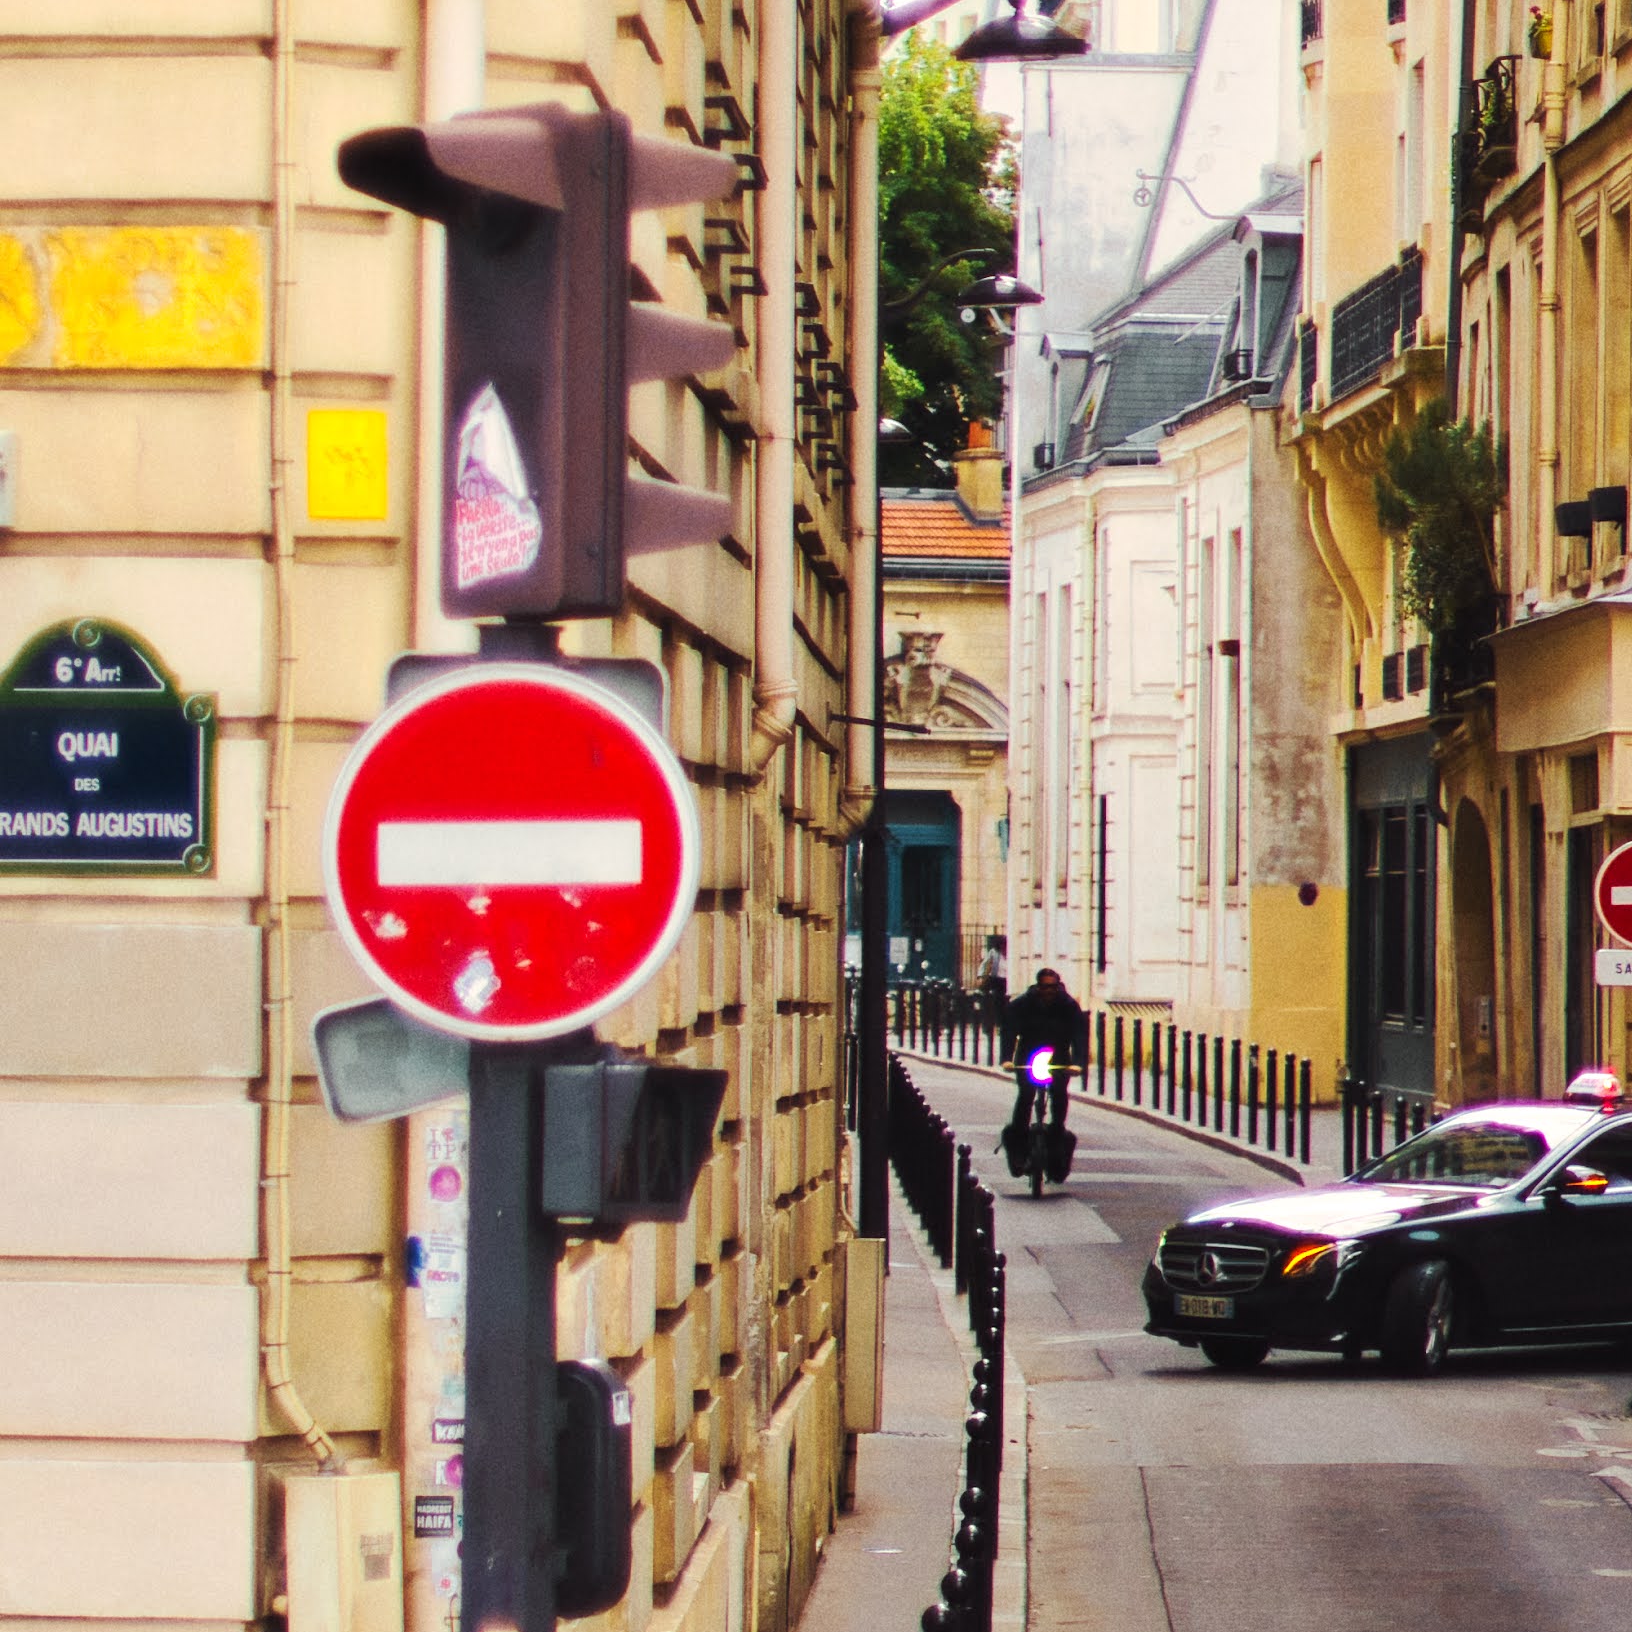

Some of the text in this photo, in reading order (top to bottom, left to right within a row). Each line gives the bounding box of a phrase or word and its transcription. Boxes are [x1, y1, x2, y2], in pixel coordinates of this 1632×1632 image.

[58, 732, 118, 762] QUAI
[74, 778, 100, 791] DES
[76, 812, 193, 838] AUGUSTINS
